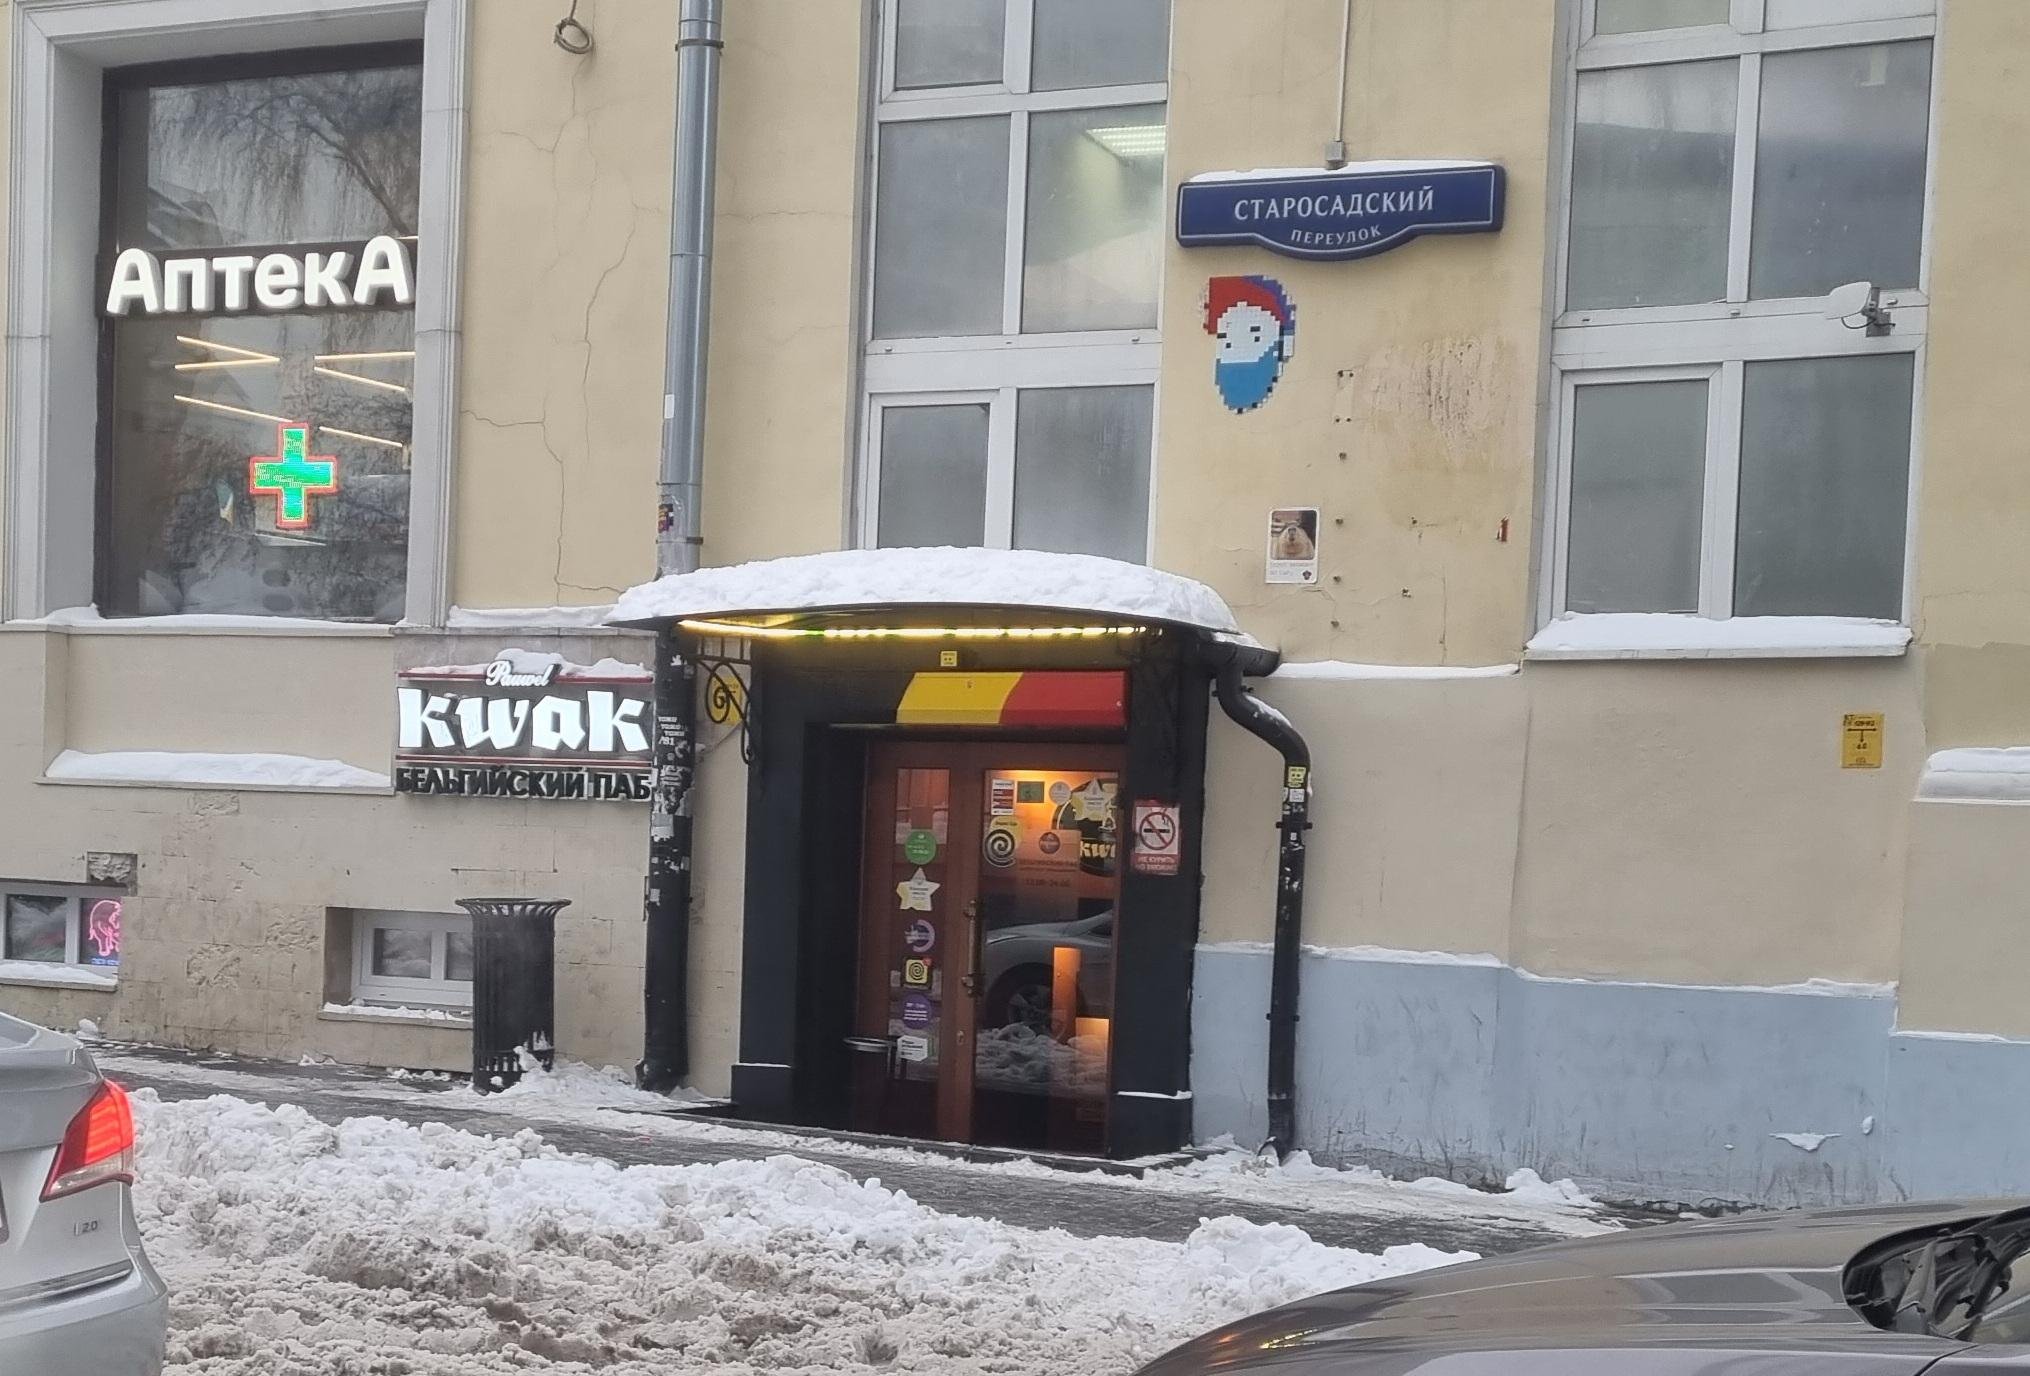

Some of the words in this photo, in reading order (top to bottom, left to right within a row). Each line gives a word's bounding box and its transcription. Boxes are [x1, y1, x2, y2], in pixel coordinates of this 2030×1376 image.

[1233, 185, 1434, 220] СТАРОСАДСКИЙ
[1291, 225, 1382, 246] ПЕРЕУЛОК
[486, 660, 557, 687] Pauwel
[395, 766, 585, 798] БЕЛЬГИЙСКИЙ
[593, 773, 651, 800] ПАБ
